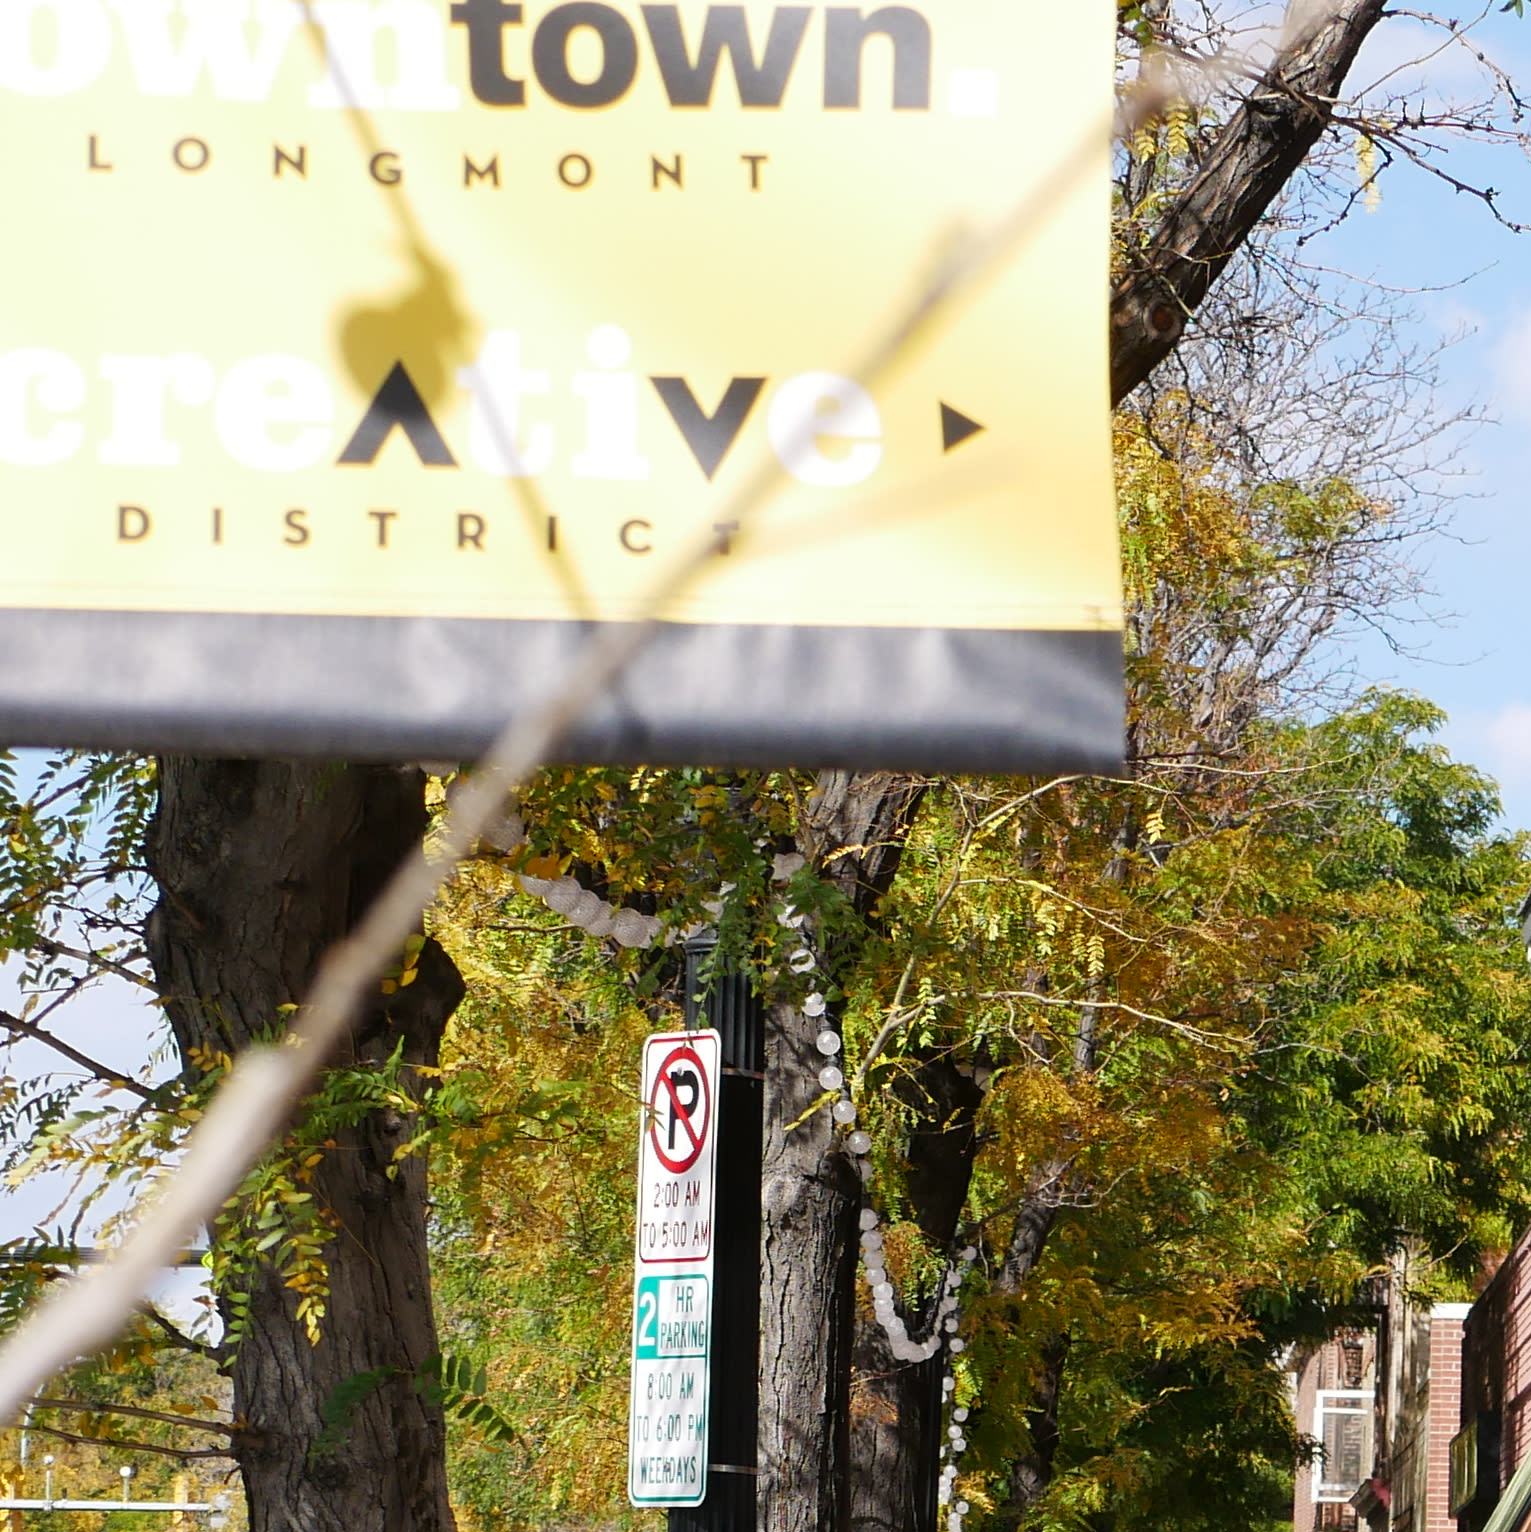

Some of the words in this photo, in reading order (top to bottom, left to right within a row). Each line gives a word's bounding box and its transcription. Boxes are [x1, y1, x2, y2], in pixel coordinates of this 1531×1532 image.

[88, 134, 769, 191] LONGMONT
[116, 504, 739, 556] DISTRICT
[653, 1181, 680, 1208] 2:00
[684, 1180, 700, 1207] AM
[643, 1222, 656, 1249] TO
[662, 1221, 687, 1249] 5:00
[692, 1221, 708, 1247] AM
[676, 1286, 694, 1313] HR
[638, 1291, 657, 1347] 2
[661, 1320, 705, 1349] PARKING
[647, 1372, 672, 1400] 8:00
[679, 1372, 694, 1399] AM
[637, 1415, 649, 1442] TO
[656, 1415, 681, 1442] 6:00
[688, 1414, 704, 1441] PM
[639, 1456, 697, 1485] WEEKDAYS
